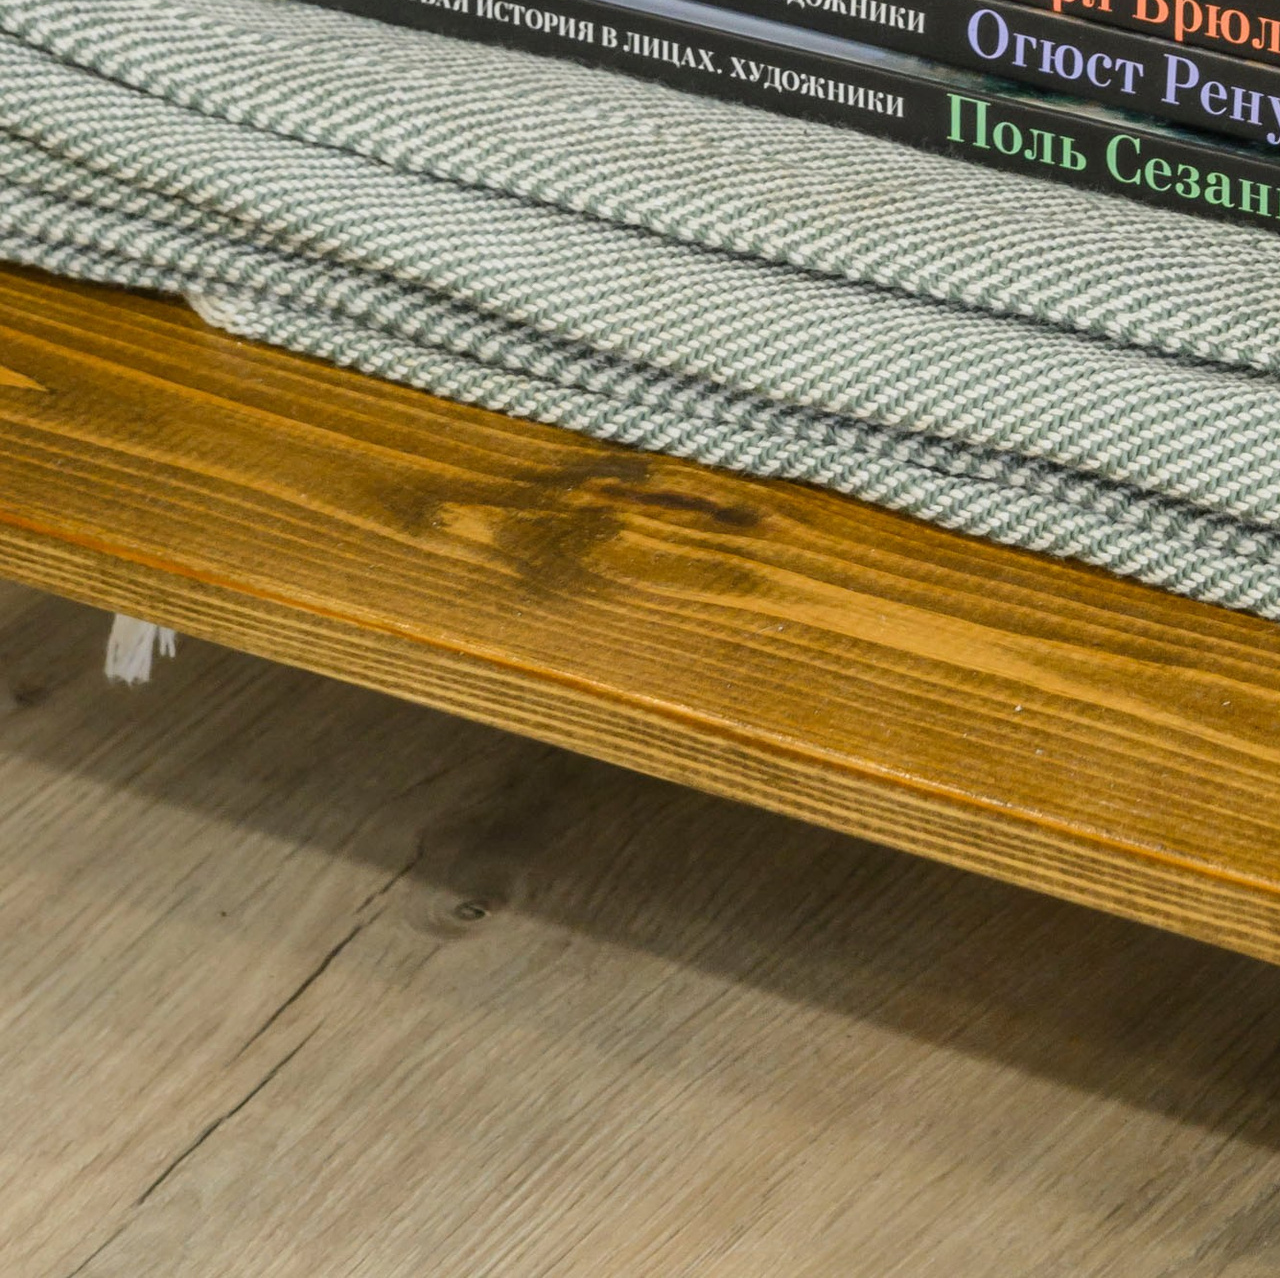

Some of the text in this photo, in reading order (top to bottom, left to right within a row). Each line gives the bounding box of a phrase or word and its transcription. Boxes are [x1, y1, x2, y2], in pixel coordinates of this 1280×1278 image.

[601, 25, 618, 49] В
[623, 31, 723, 74] ЛИЦАХ.
[730, 56, 905, 118] ХУДОЖНИКИ
[967, 9, 1144, 96] Огюст
[946, 93, 1088, 173] Поль
